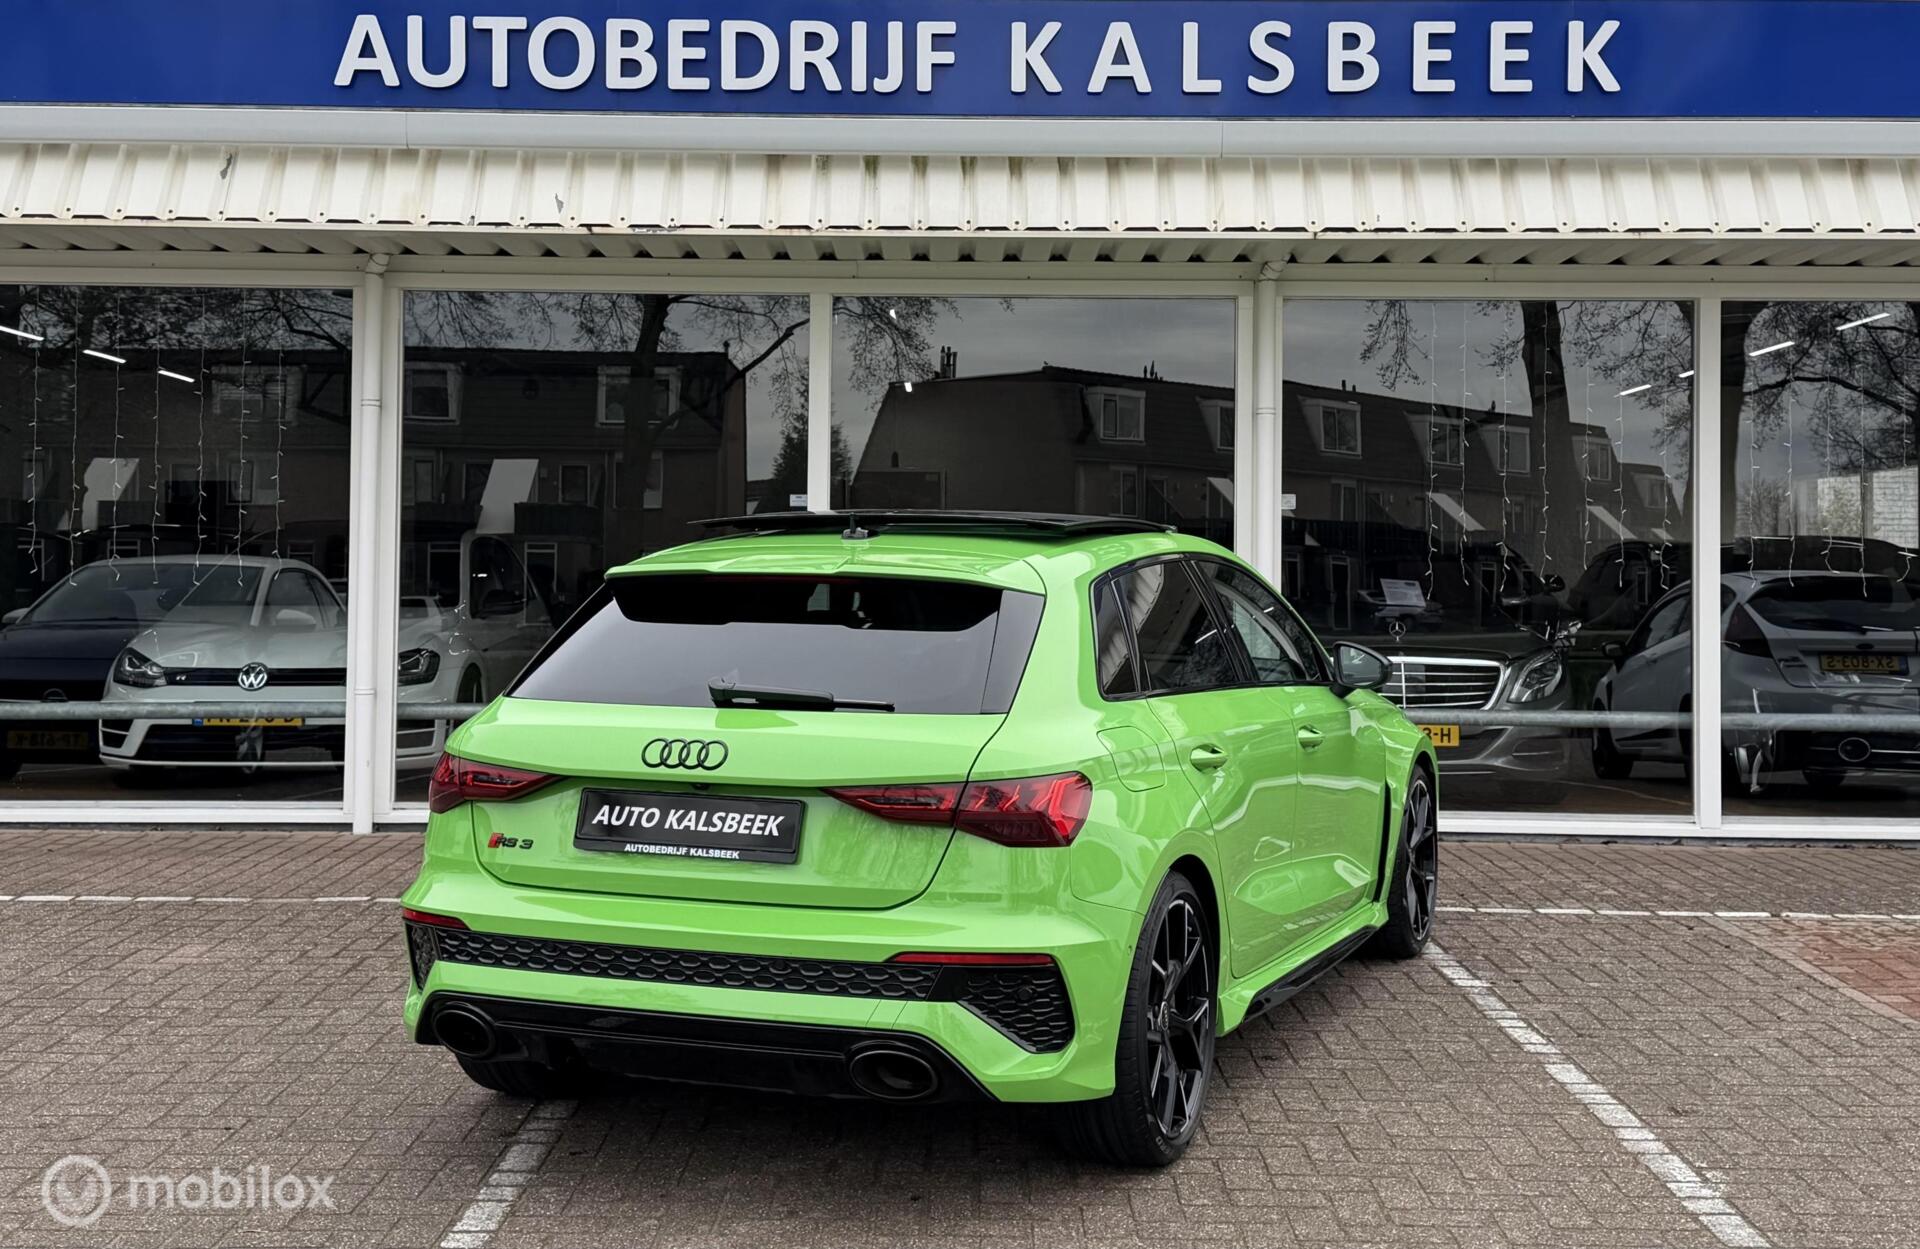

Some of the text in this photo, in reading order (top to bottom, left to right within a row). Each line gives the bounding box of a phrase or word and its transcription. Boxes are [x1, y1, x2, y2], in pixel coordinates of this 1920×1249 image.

[333, 13, 1622, 95] AUTOBEDRIJF KALSBEEK
[592, 804, 785, 837] AUTO KALSBEEK
[624, 843, 740, 860] AUTOBEDRIJF KALSBEEK
